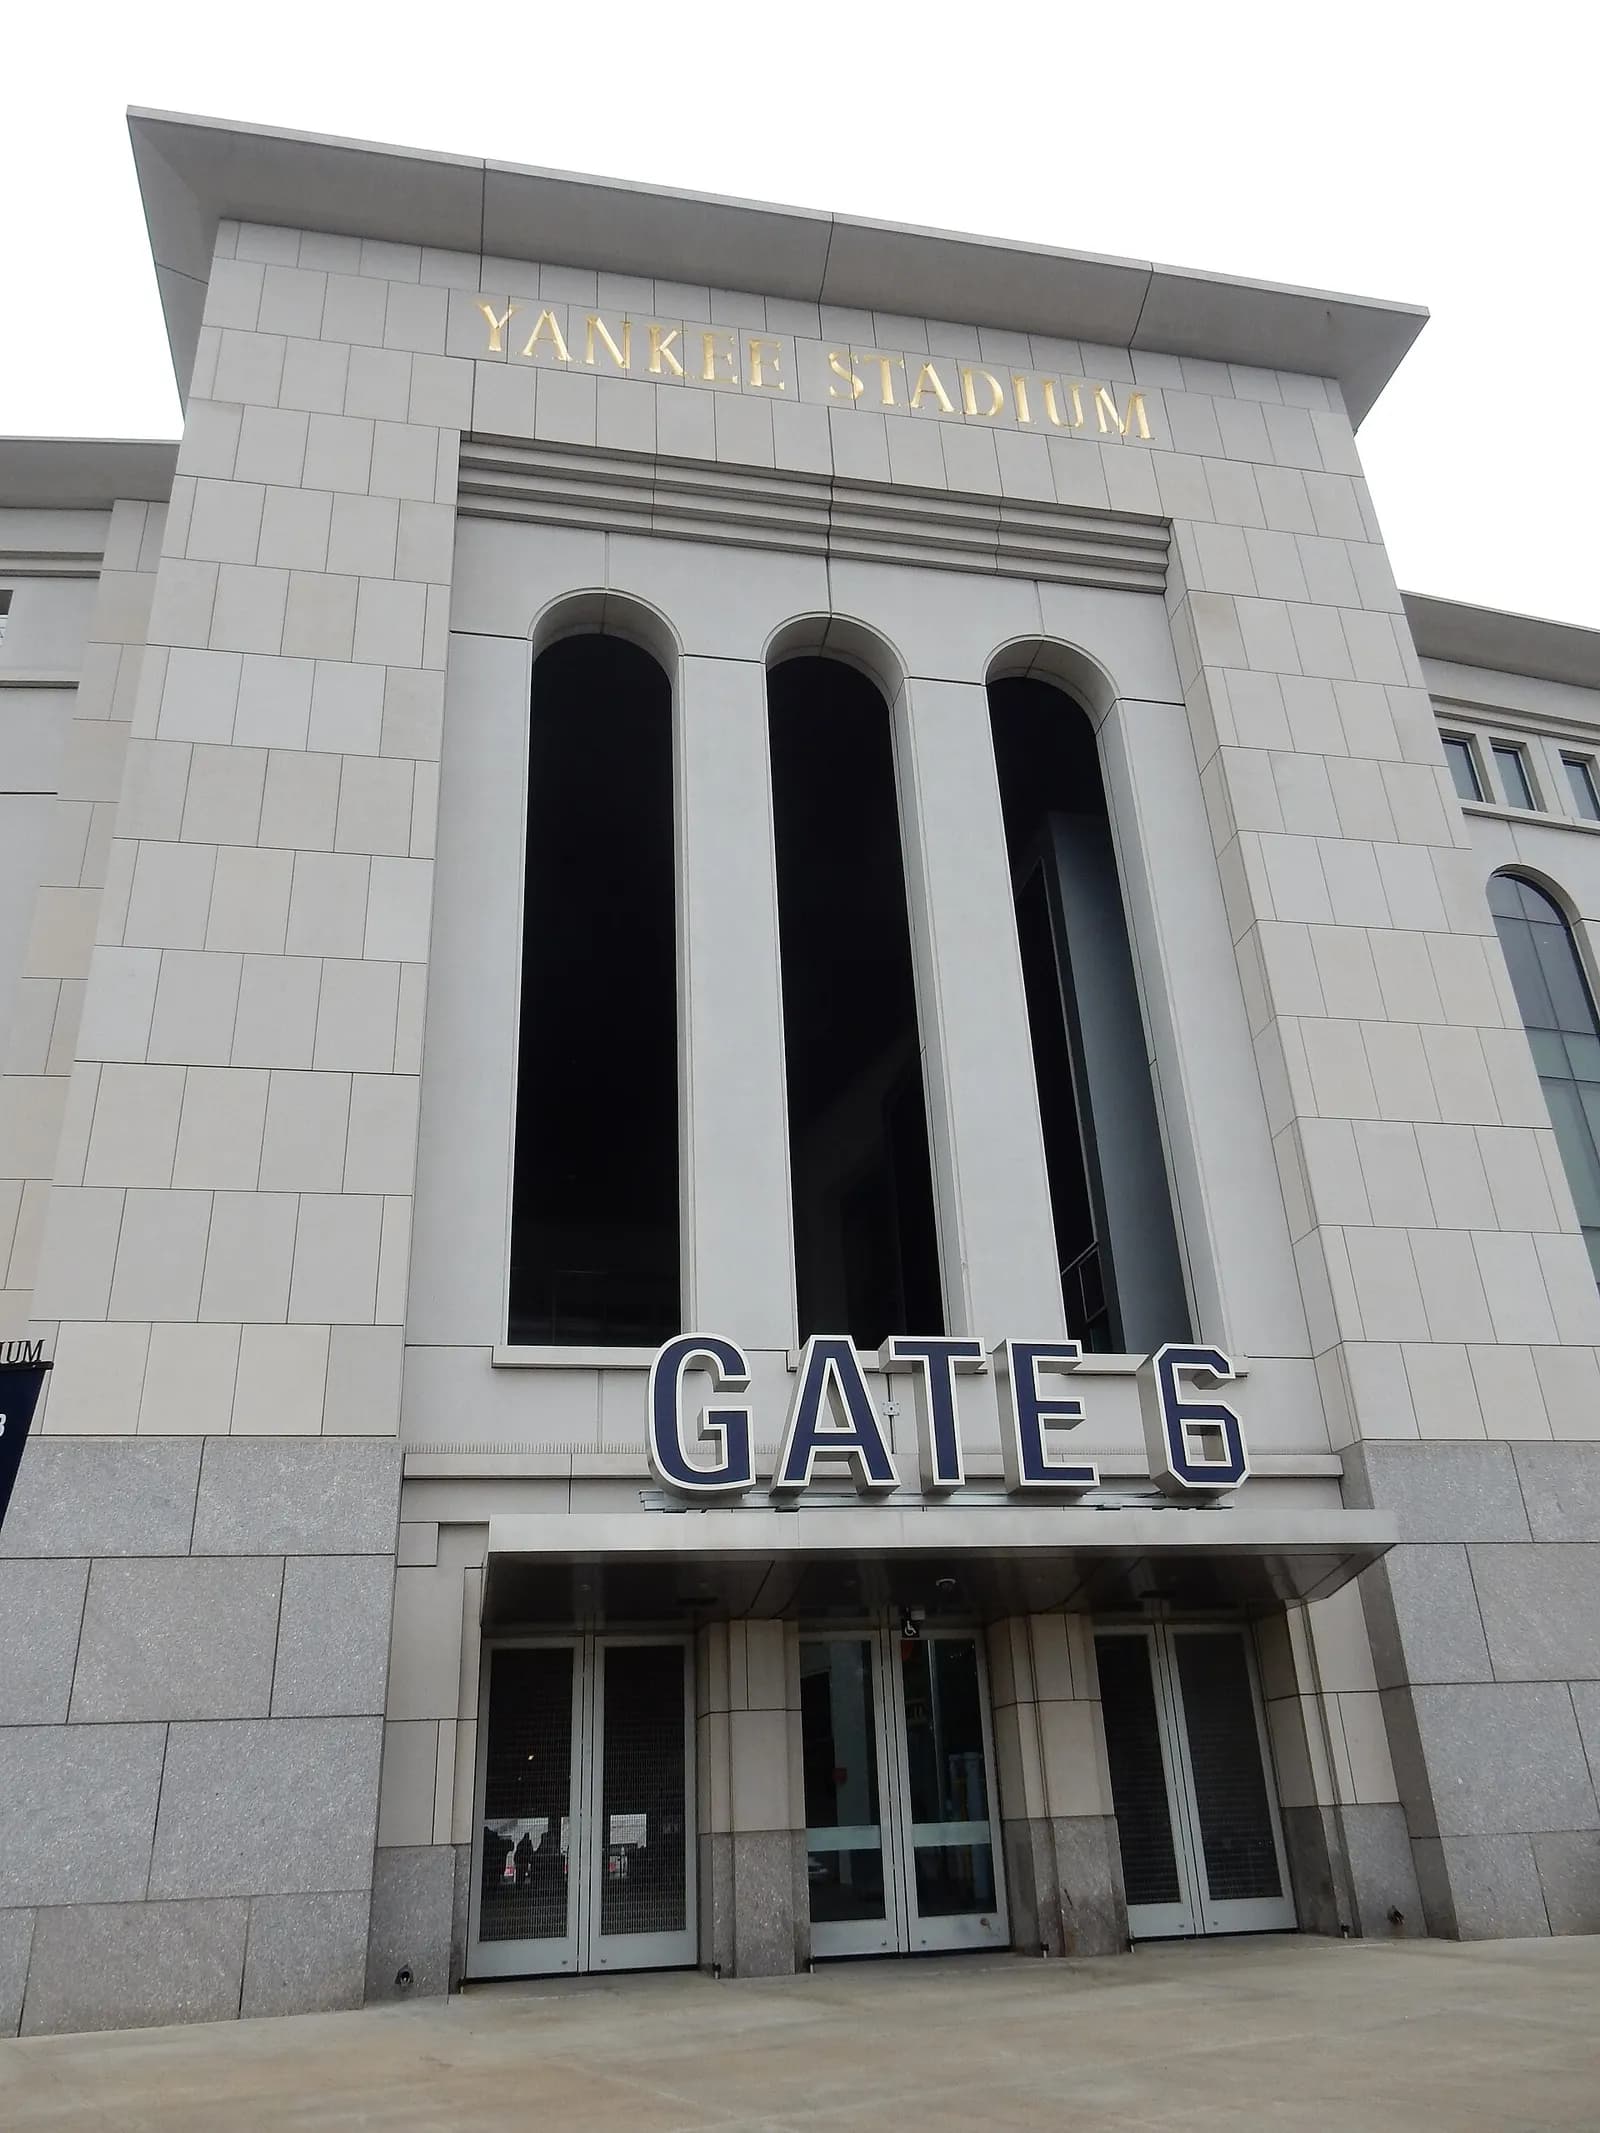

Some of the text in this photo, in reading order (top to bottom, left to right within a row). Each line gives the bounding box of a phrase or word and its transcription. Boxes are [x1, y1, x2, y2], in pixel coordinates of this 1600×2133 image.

[479, 303, 1156, 440] YANKEE STADIUM
[648, 1332, 1250, 1496] GATE 6
